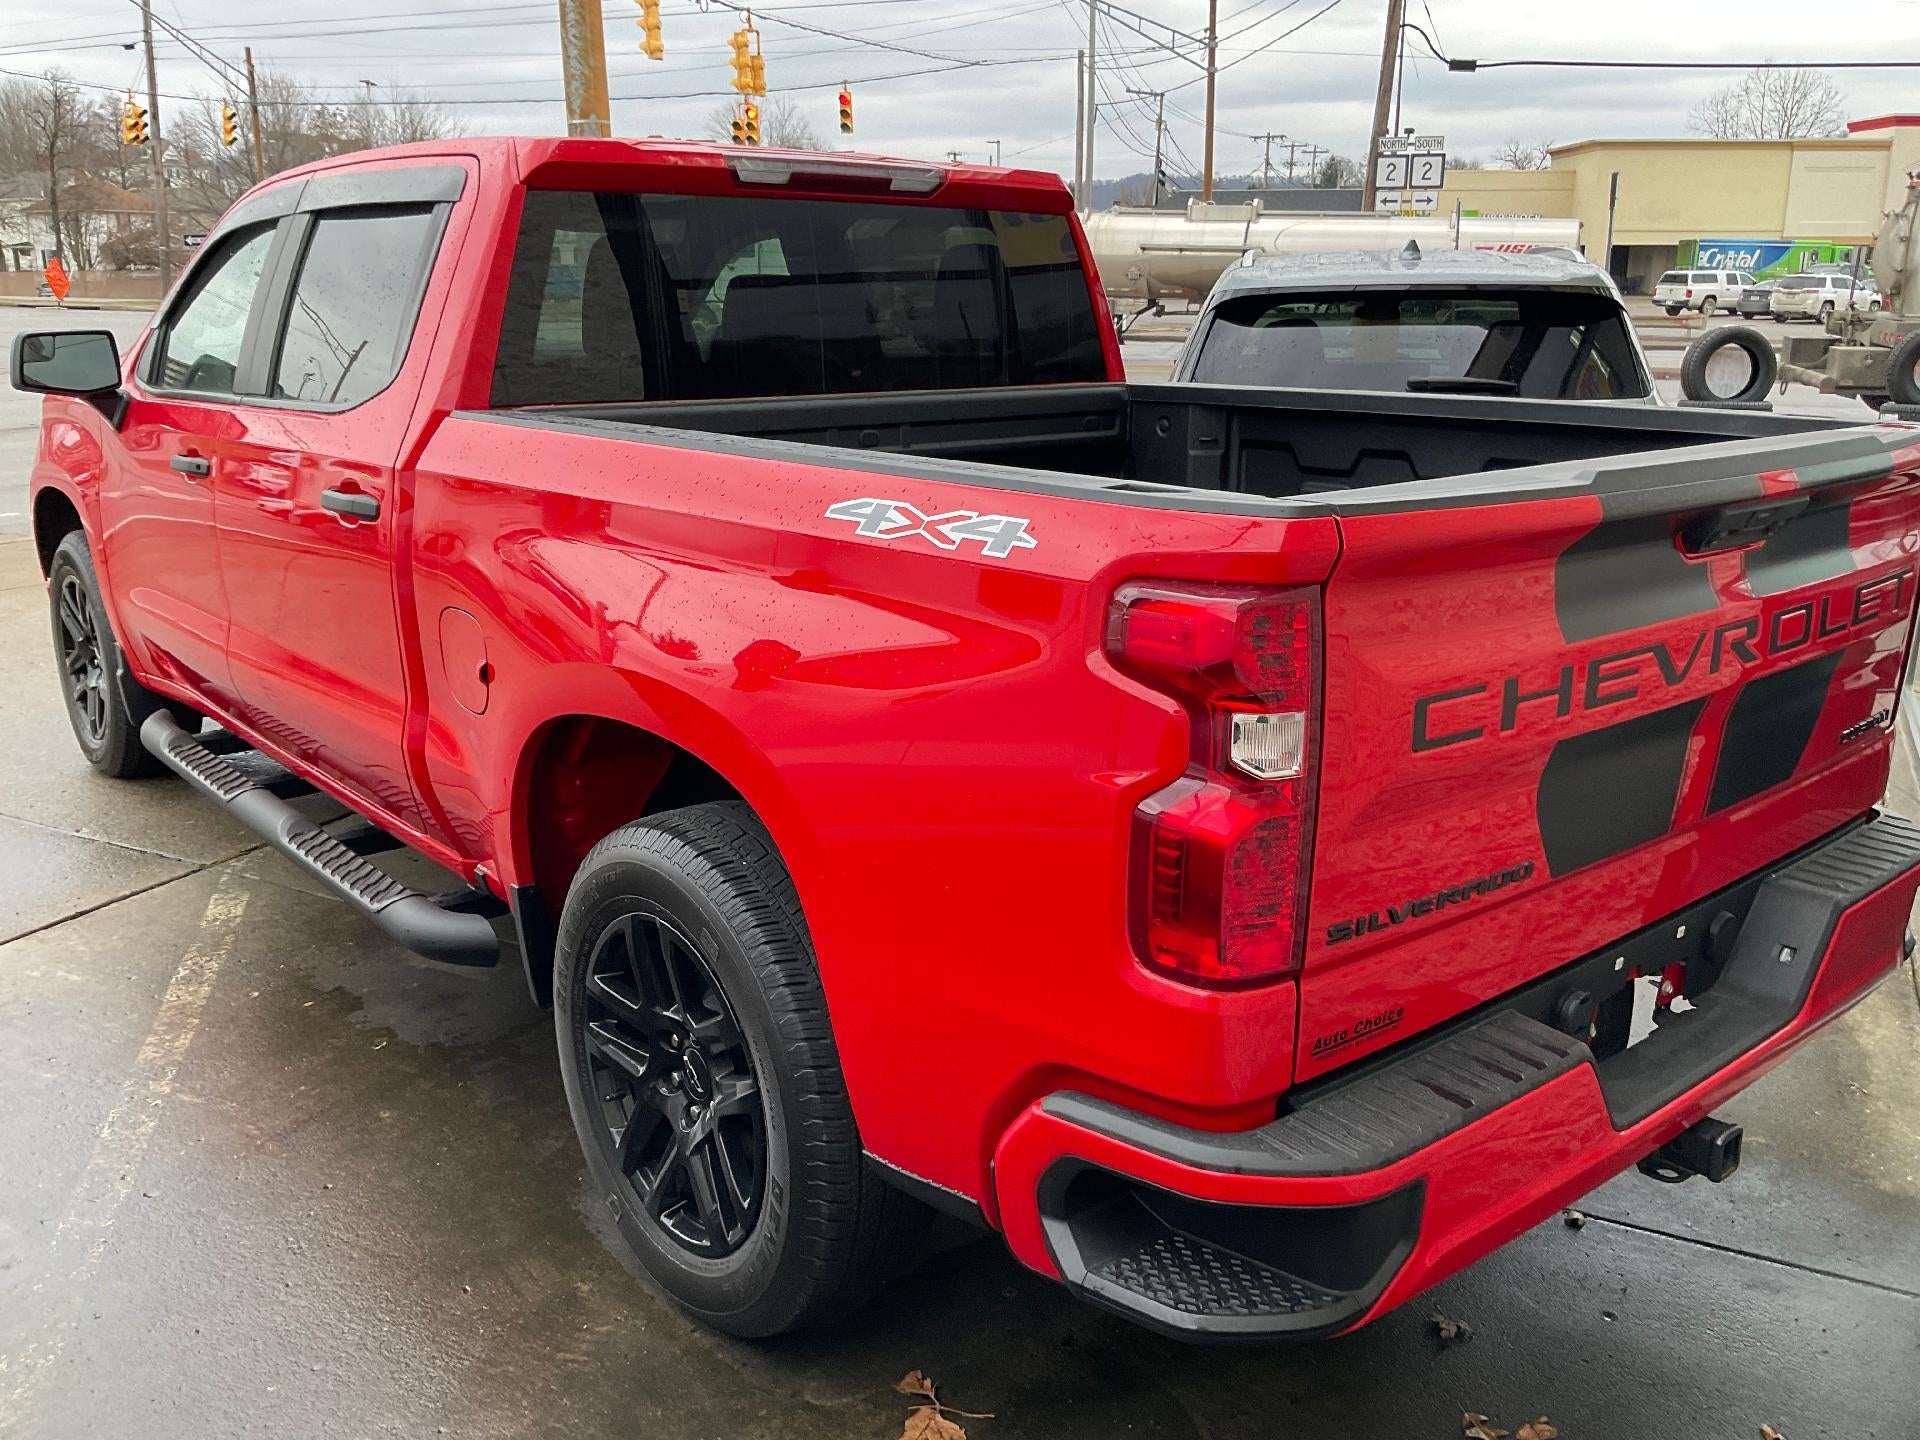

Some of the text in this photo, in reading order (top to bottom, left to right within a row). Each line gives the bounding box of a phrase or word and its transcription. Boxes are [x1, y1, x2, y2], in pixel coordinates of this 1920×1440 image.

[1380, 139, 1406, 150] NORTH
[1416, 138, 1442, 149] SOUTH
[1385, 162, 1397, 181] 2
[1421, 161, 1433, 180] 2
[1411, 566, 1915, 753] CHEVROLET
[1326, 861, 1535, 946] SILVERADO
[1312, 1029, 1348, 1051] Auto
[1353, 1007, 1405, 1035] Choice
